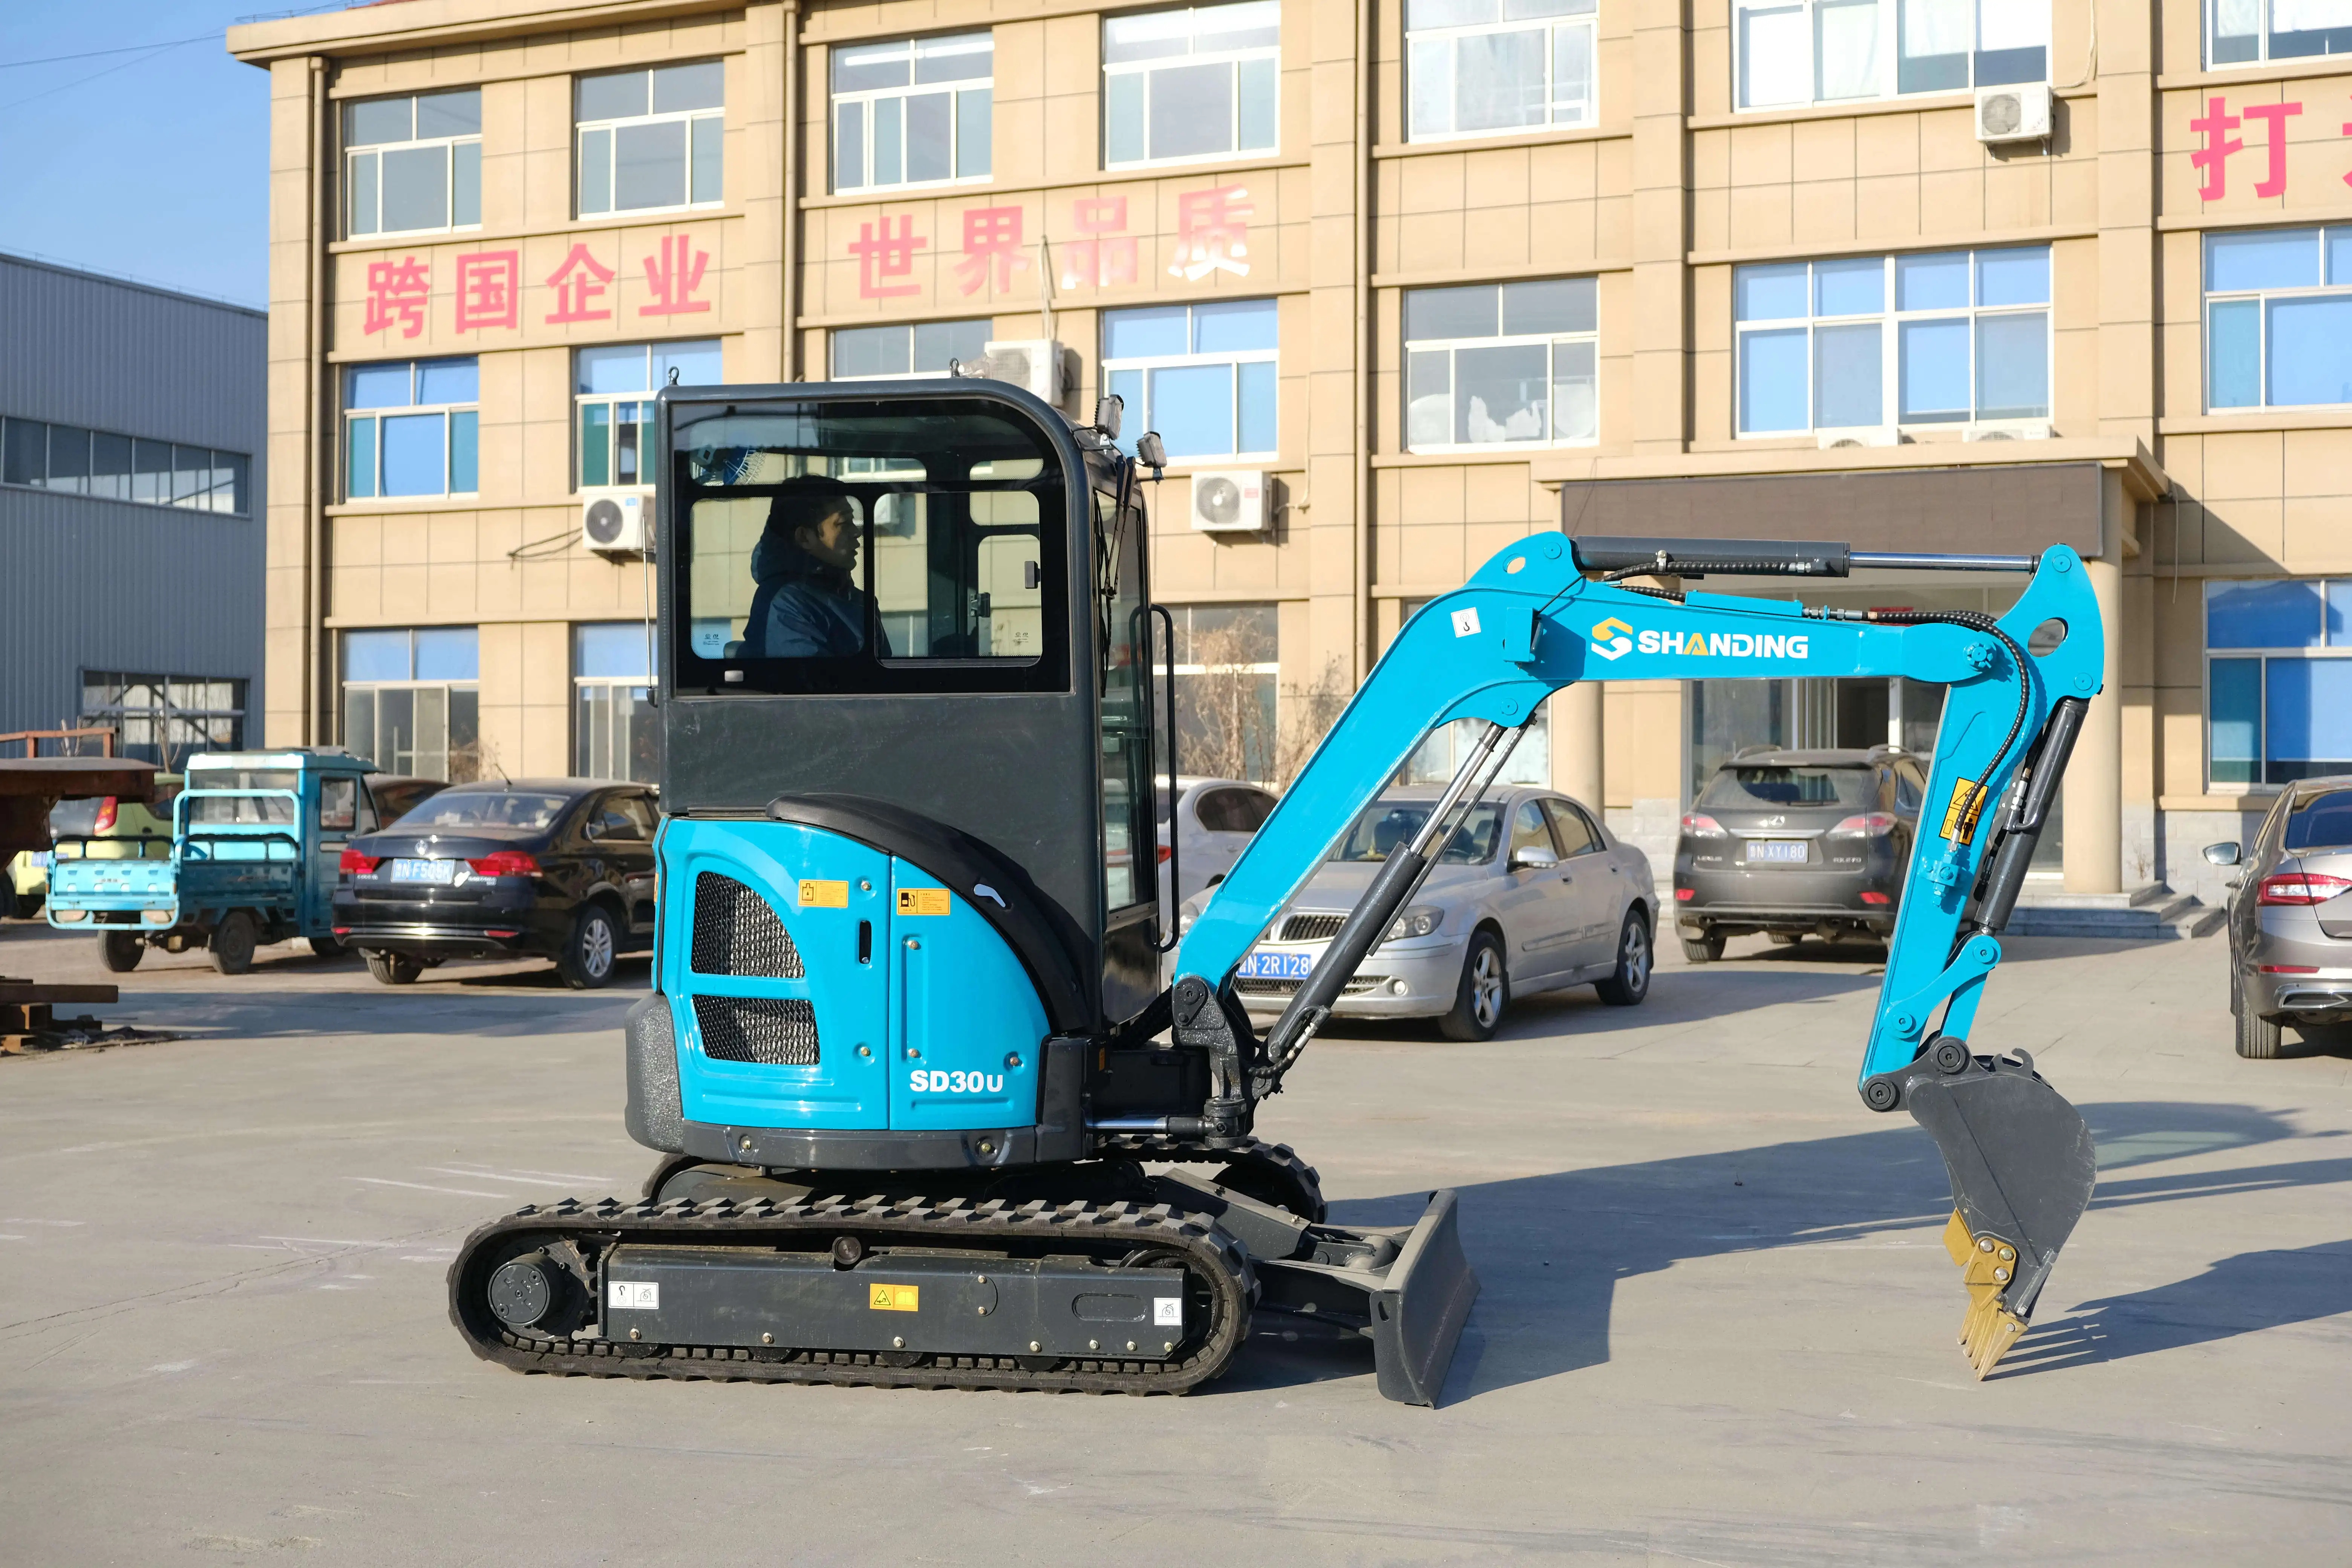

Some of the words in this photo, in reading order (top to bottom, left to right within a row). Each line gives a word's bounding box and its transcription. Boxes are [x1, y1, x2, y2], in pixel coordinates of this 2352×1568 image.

[2190, 94, 2352, 198] 打
[364, 234, 710, 339] 跨国企业
[848, 184, 1254, 299] 世界品质
[1637, 630, 1808, 659] SHANDING
